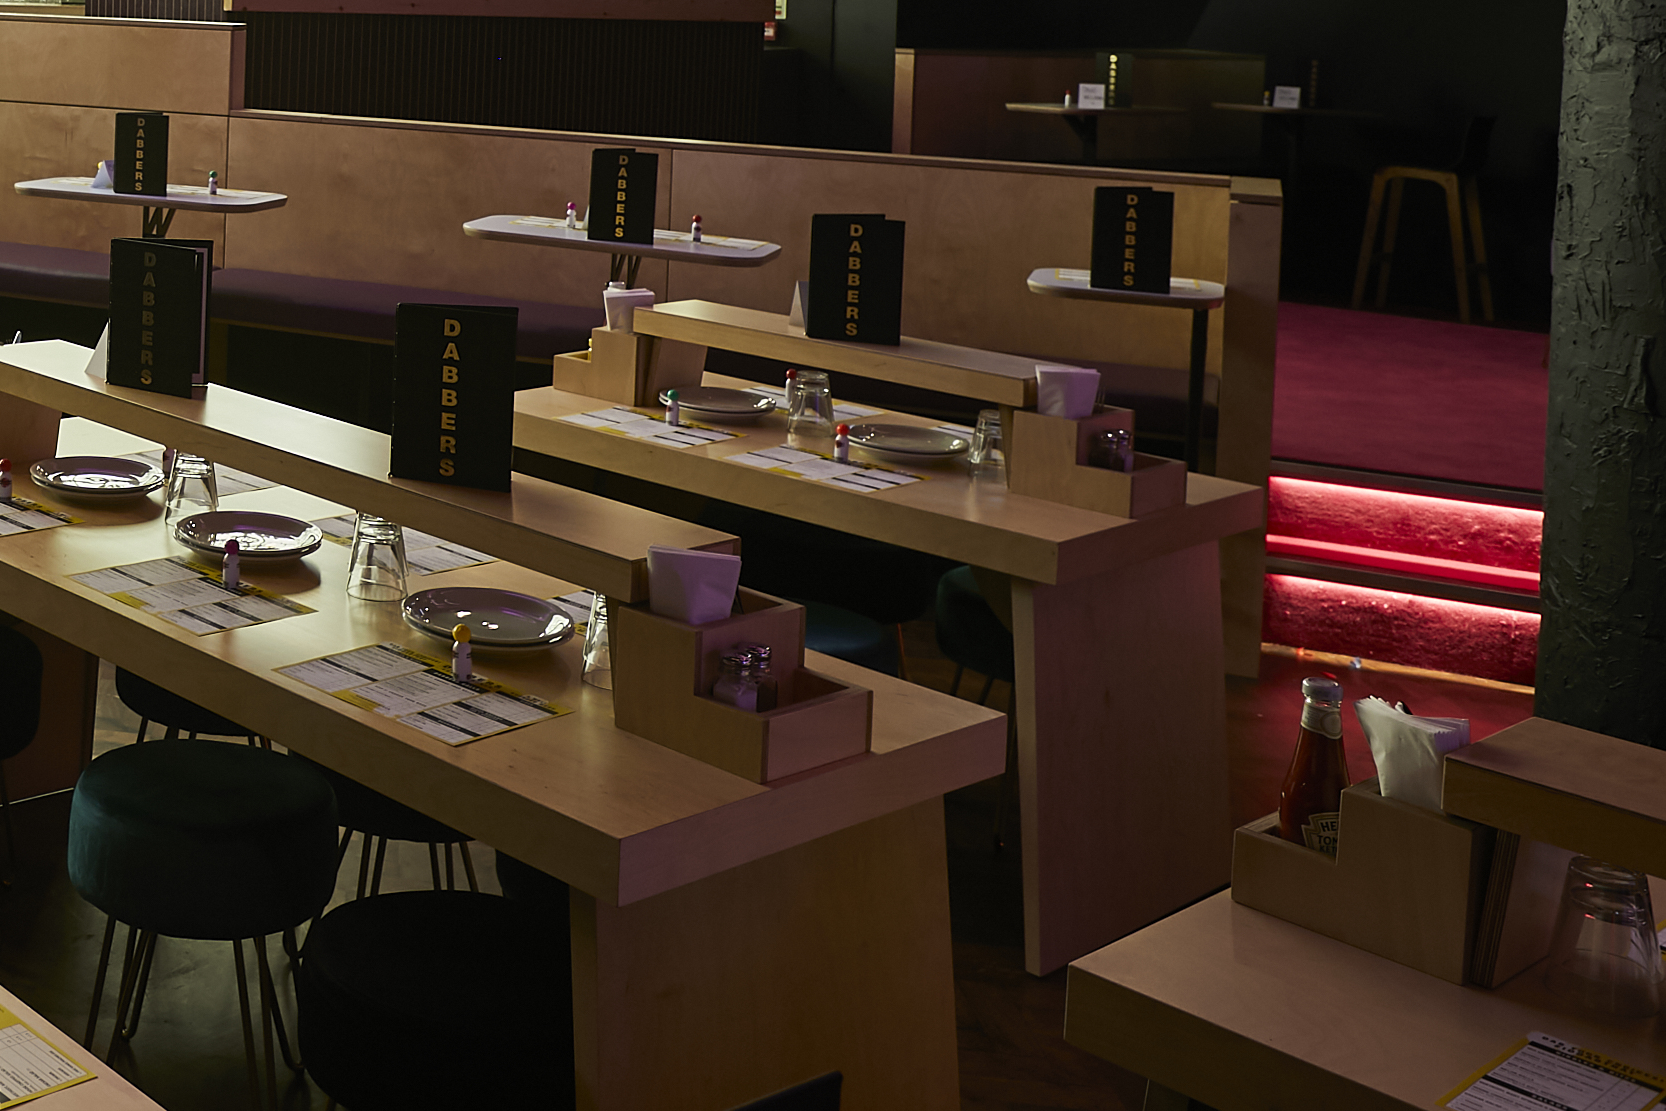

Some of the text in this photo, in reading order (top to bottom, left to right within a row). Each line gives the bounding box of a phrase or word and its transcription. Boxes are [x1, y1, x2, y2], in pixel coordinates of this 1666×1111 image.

[134, 117, 146, 192] DABBERS
[614, 154, 628, 239] DABBERS
[844, 223, 863, 338] DABBERS
[1122, 193, 1139, 287] DABBERS
[139, 251, 157, 386] DABBERS
[439, 317, 461, 478] DABBERS
